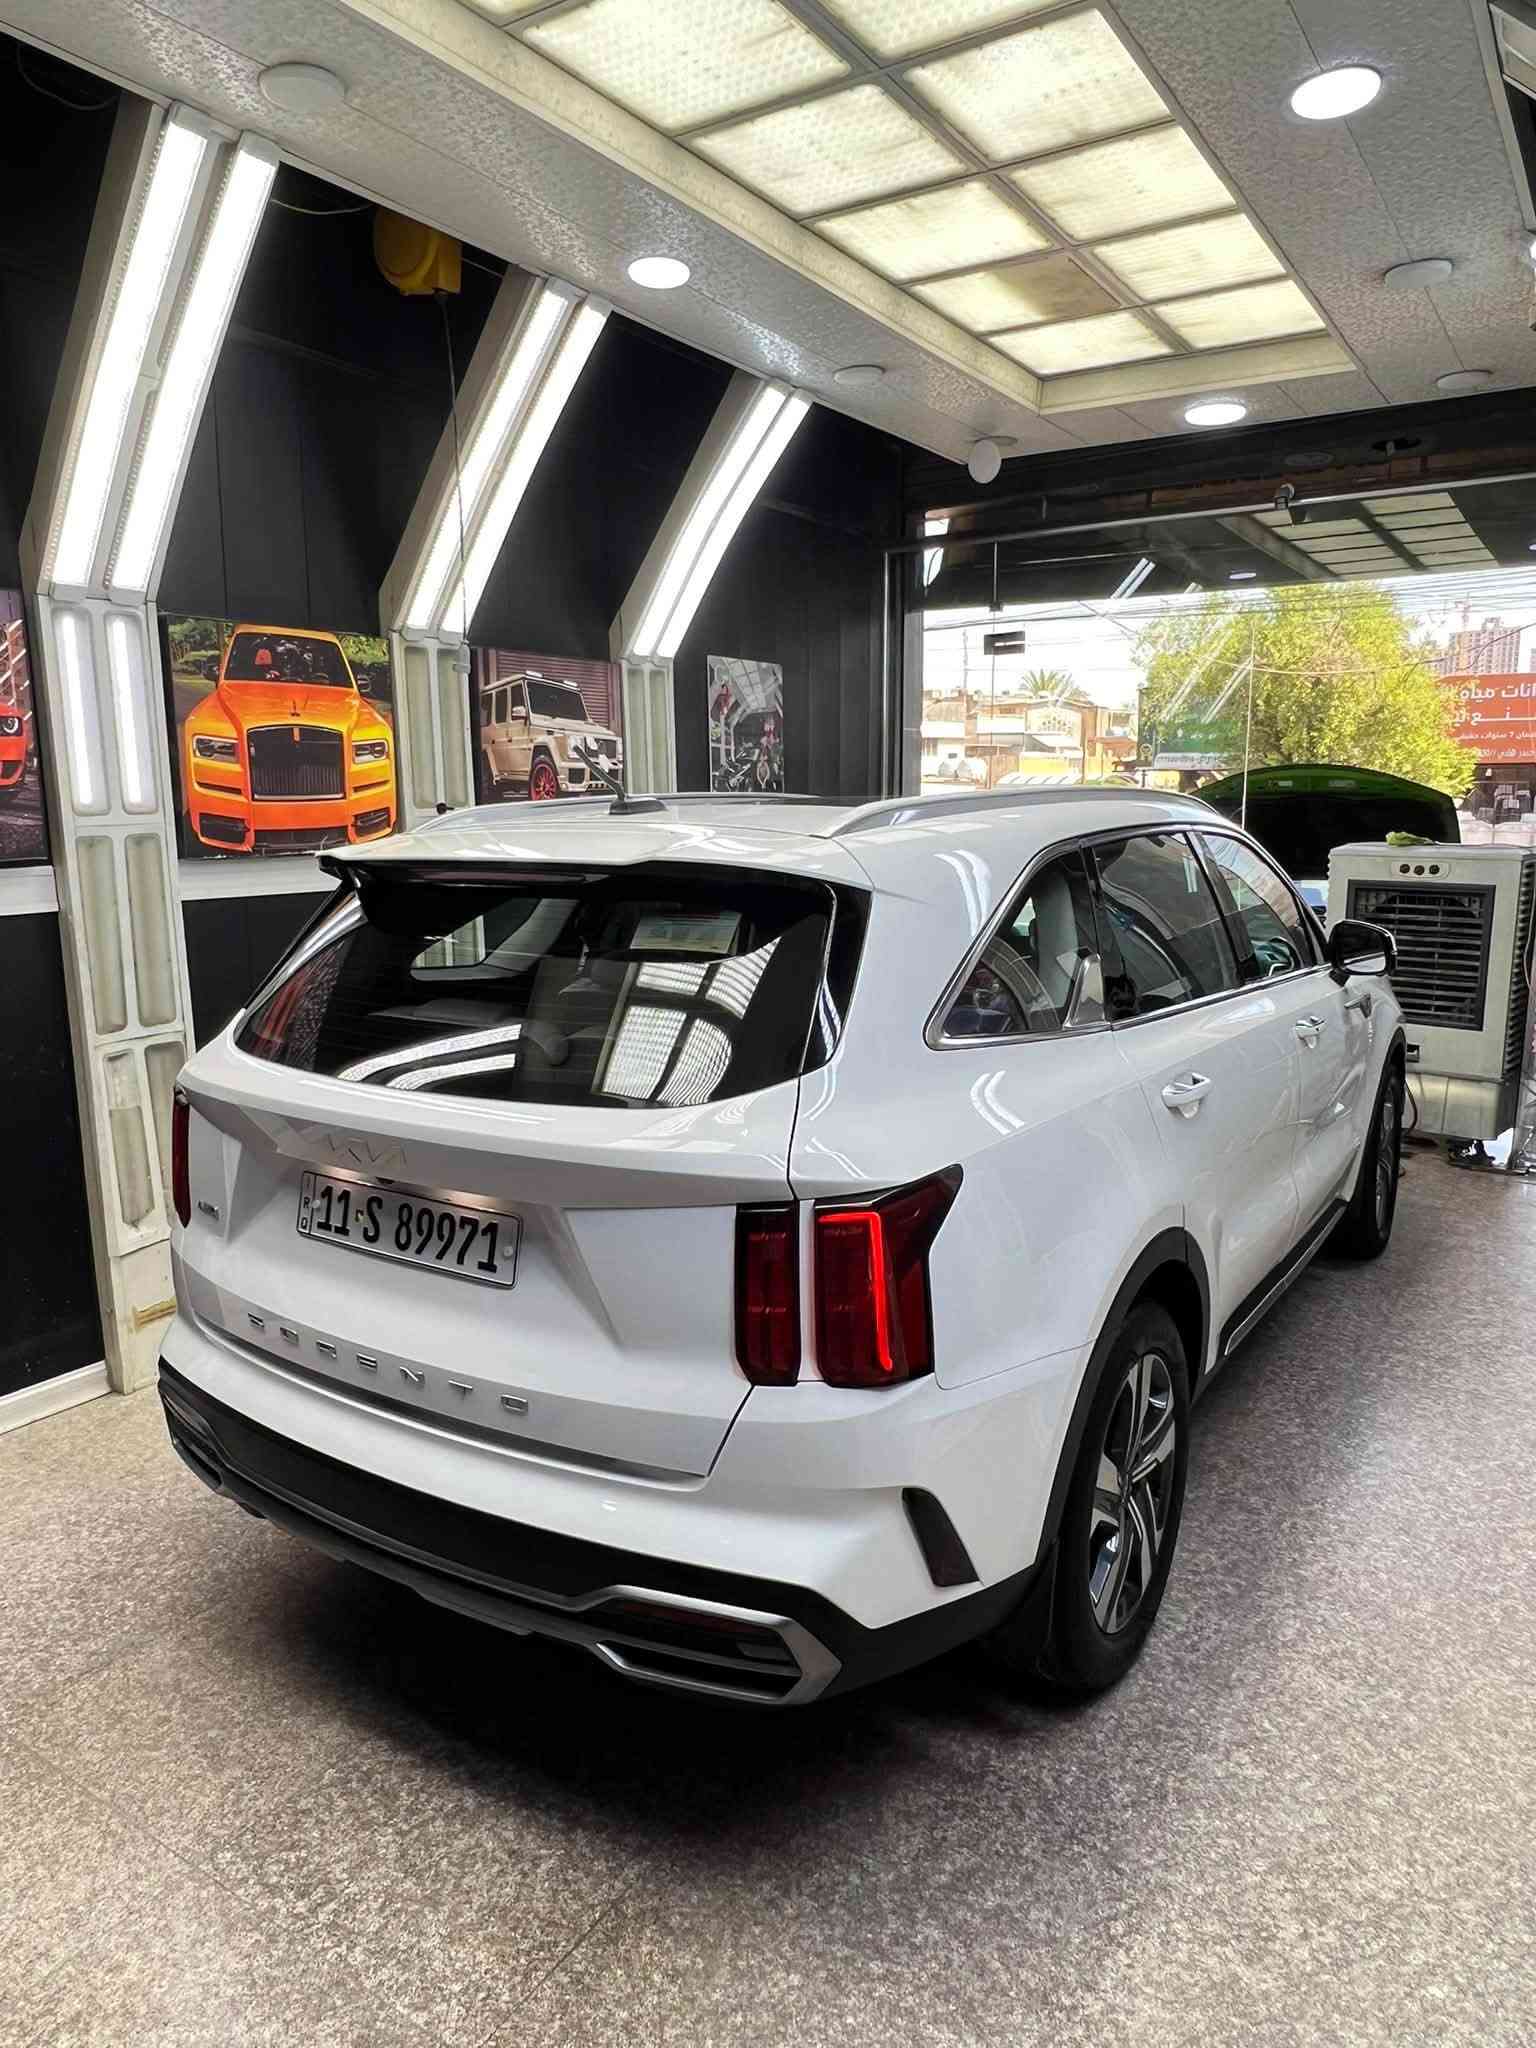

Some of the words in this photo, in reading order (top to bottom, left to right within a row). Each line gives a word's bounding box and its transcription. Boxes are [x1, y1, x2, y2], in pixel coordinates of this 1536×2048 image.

[316, 1184, 353, 1237] 11
[362, 1195, 384, 1244] S
[394, 1202, 499, 1274] 89971
[247, 1312, 529, 1414] SORENTO
